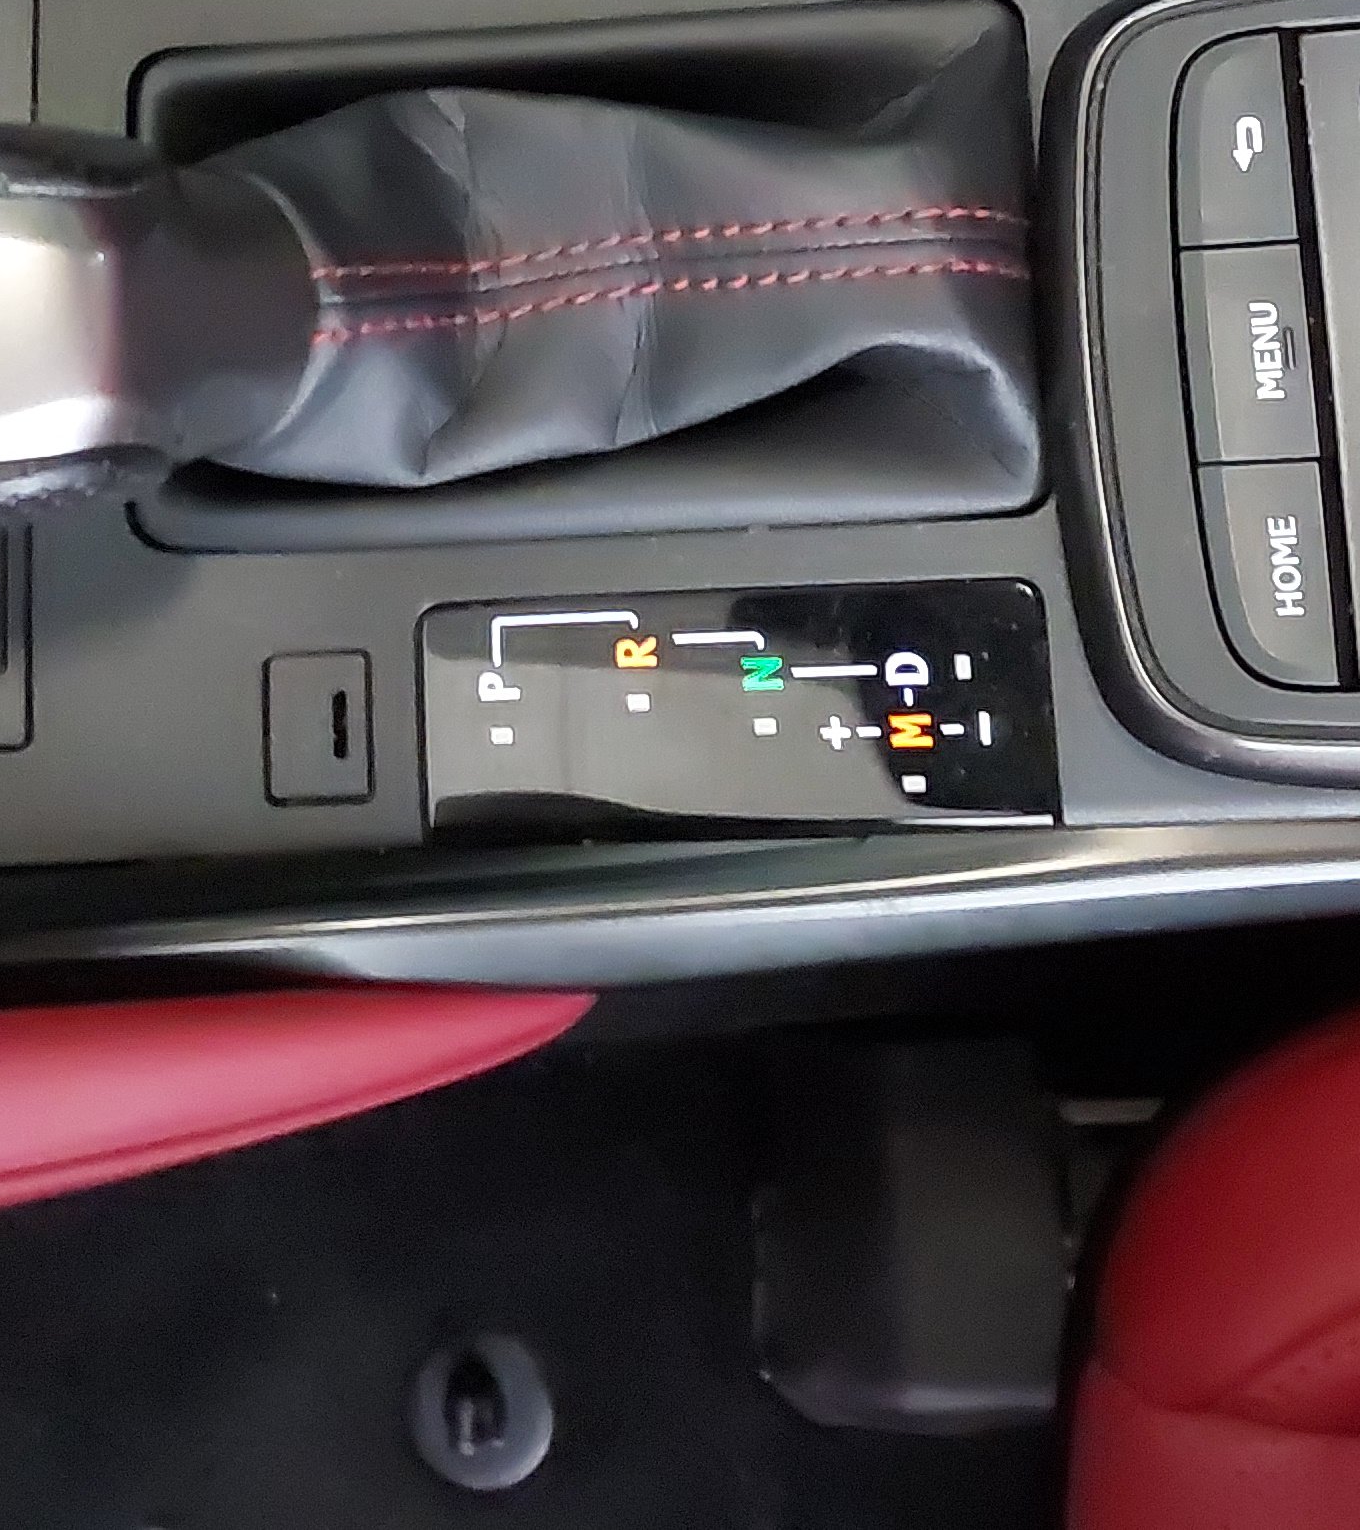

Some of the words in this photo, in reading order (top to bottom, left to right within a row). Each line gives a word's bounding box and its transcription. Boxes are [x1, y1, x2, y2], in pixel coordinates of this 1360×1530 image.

[1248, 301, 1287, 401] MENU
[1266, 514, 1306, 617] HOME
[478, 670, 522, 702] P
[616, 636, 658, 668] R
[740, 656, 785, 691] N
[885, 651, 930, 686] D
[887, 712, 935, 750] M
